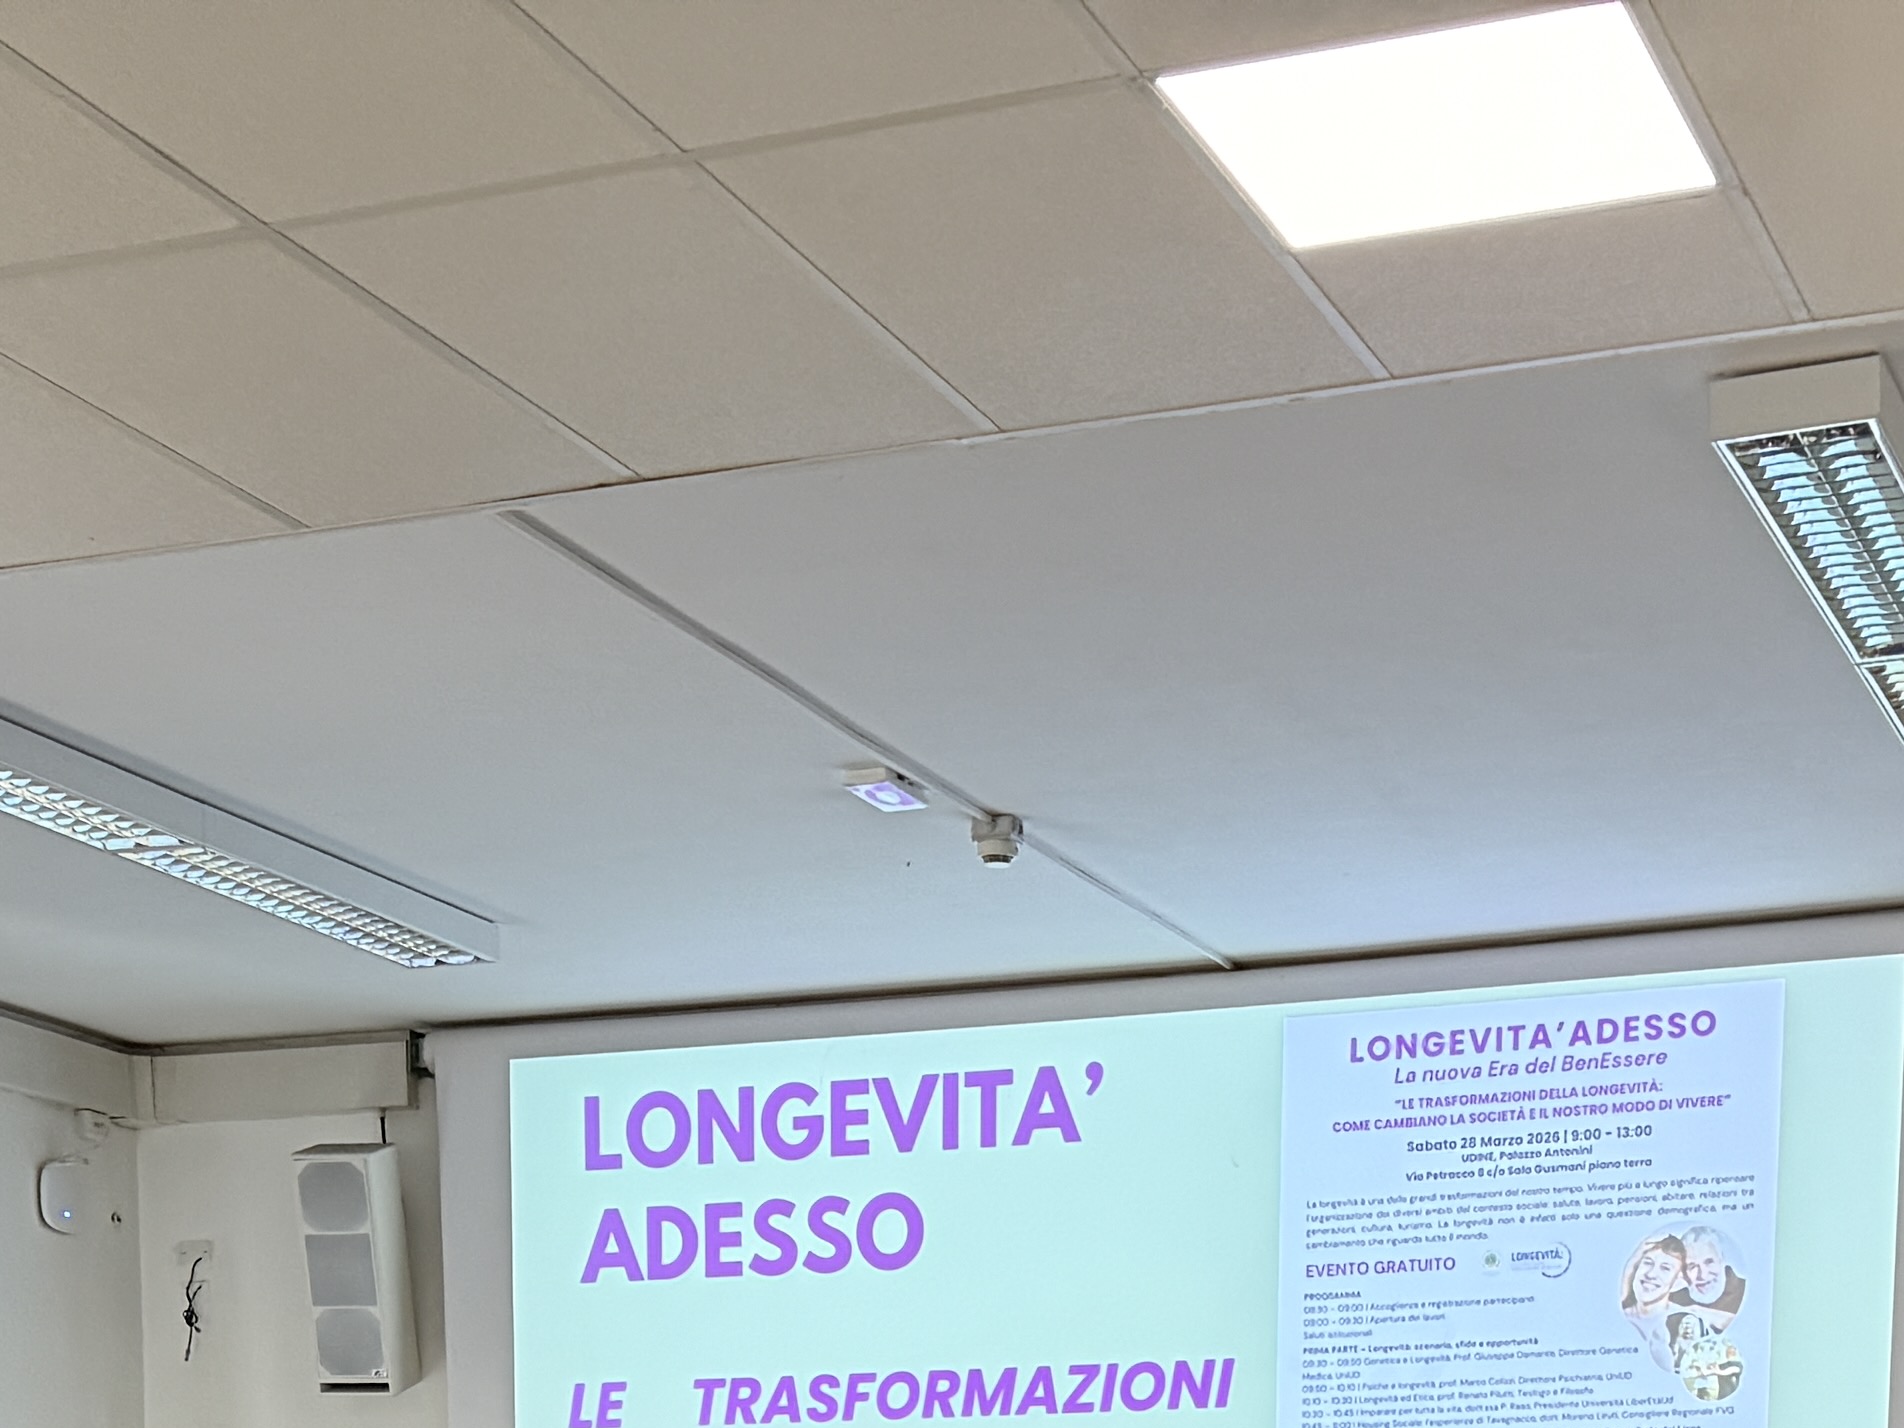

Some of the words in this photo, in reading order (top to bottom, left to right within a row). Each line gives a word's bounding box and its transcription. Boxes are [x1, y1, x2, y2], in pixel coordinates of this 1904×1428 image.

[1394, 1067, 1416, 1084] La
[1422, 1066, 1482, 1082] nuova
[1488, 1060, 1518, 1077] Era
[1525, 1056, 1556, 1074] del
[1562, 1052, 1667, 1072] BenEssere
[1419, 1089, 1535, 1109] TRASFORMAZIONI
[1539, 1086, 1578, 1100] DELLA
[1582, 1078, 1663, 1097] LONGEVITÀ:
[584, 1061, 1104, 1171] LONGEVITA'
[1332, 1120, 1370, 1133] COME
[1374, 1115, 1446, 1130] CAMBIANO
[1450, 1113, 1465, 1125] LA
[1470, 1106, 1525, 1124] SOCIETÀ
[1529, 1108, 1535, 1120] E
[1540, 1108, 1549, 1119] IL
[1552, 1104, 1608, 1118] NOSTRO
[1612, 1100, 1655, 1114] MODO
[1659, 1099, 1672, 1110] DI
[1407, 1139, 1457, 1152] Sabato
[1460, 1137, 1476, 1149] 28
[1480, 1134, 1523, 1148] Marzo
[1527, 1131, 1560, 1145] 2026
[1571, 1128, 1601, 1142] 9:00
[1616, 1125, 1652, 1139] 13:00
[582, 1192, 925, 1284] ADESSO
[1306, 1262, 1369, 1278] EVENTO
[1374, 1257, 1456, 1274] GRATUITO
[693, 1357, 1235, 1427] TRASFORMAZIONI
